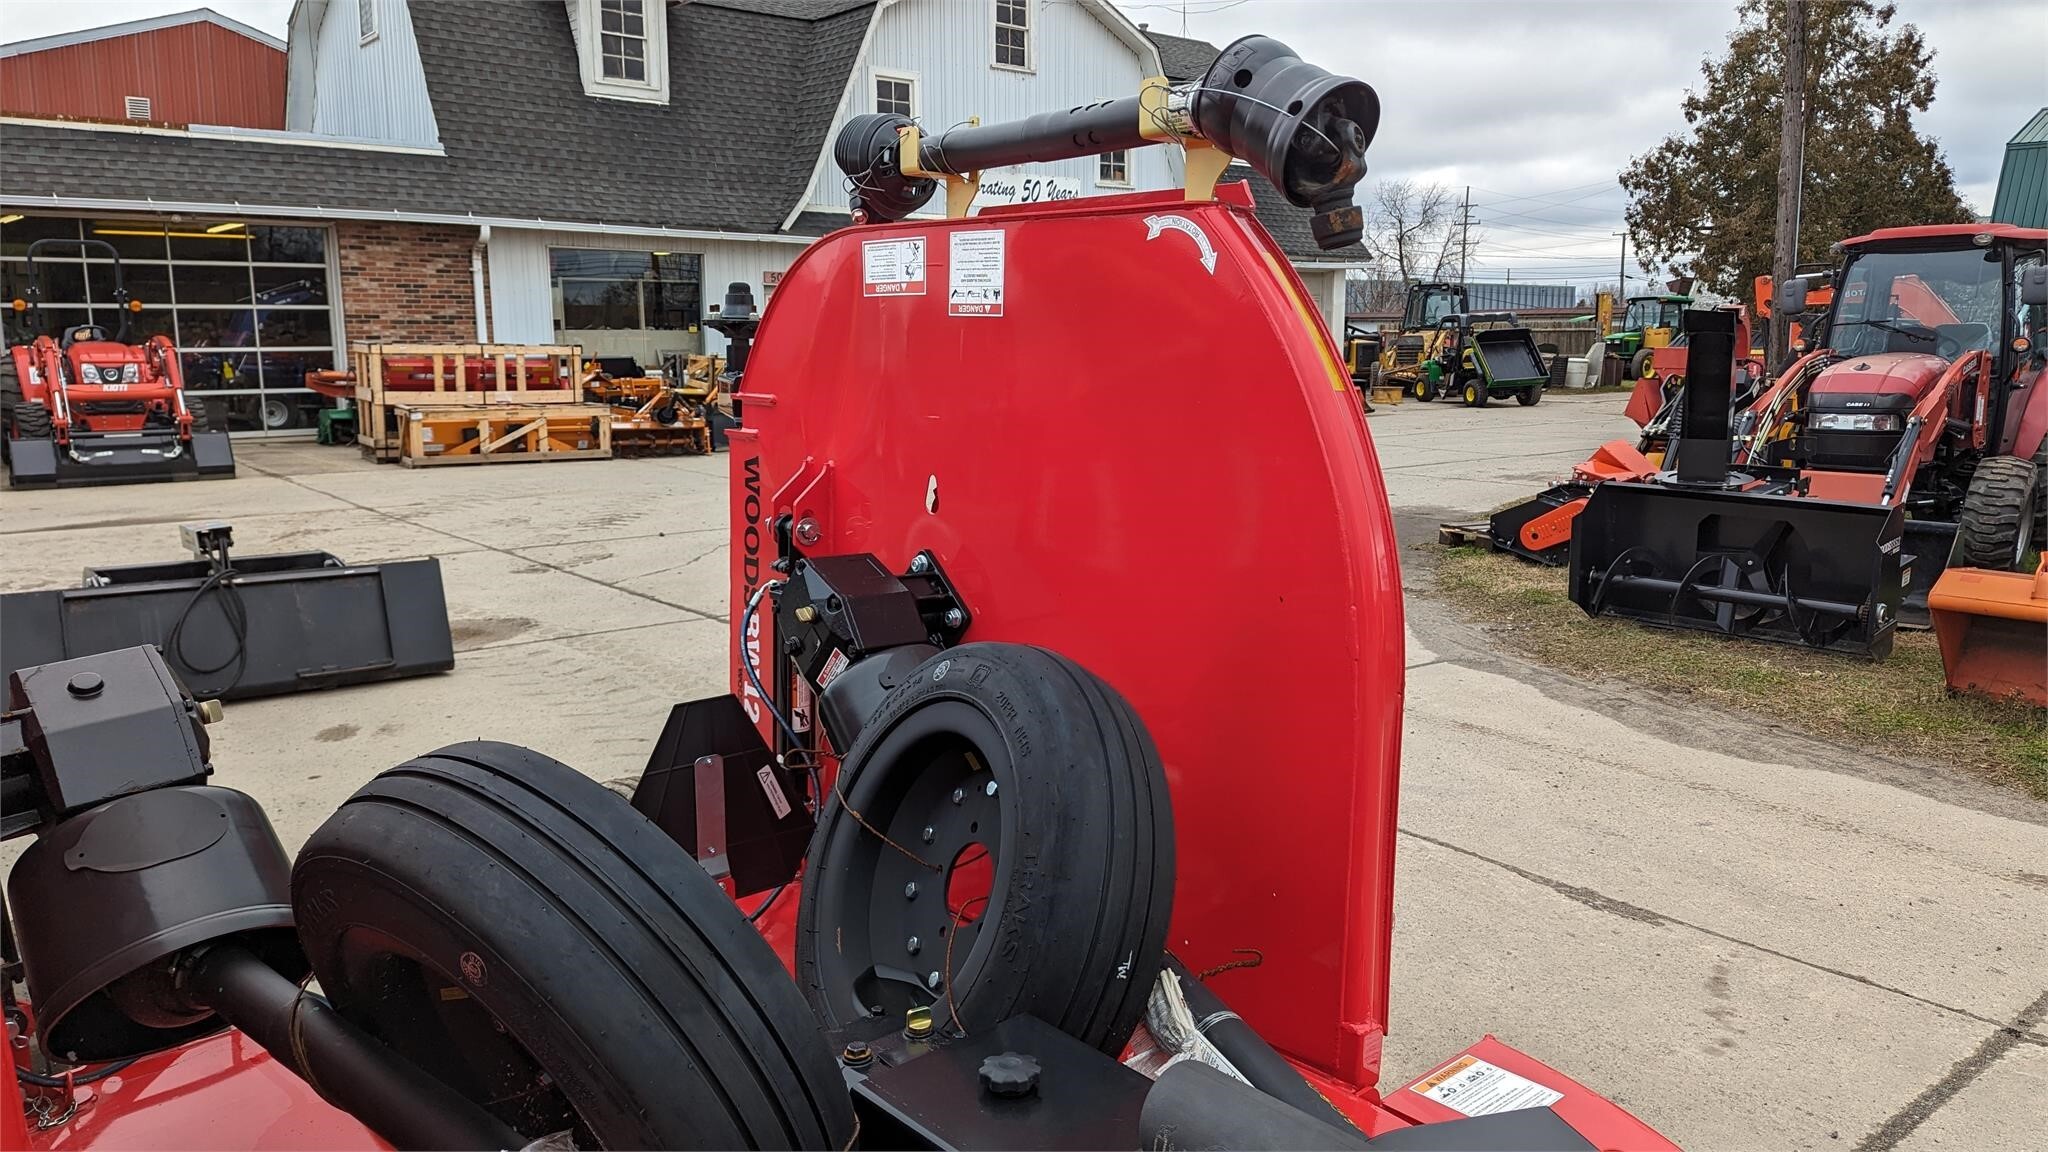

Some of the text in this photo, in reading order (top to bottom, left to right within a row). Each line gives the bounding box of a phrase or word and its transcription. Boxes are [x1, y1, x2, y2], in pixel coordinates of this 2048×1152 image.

[979, 179, 1079, 203] rating 50 Years
[1171, 217, 1200, 239] ROTATION
[875, 283, 902, 294] DANGER
[958, 304, 984, 314] DANGER
[102, 383, 128, 392] KIOTI
[743, 456, 761, 608] WOODS
[1434, 1061, 1469, 1083] WARNING
